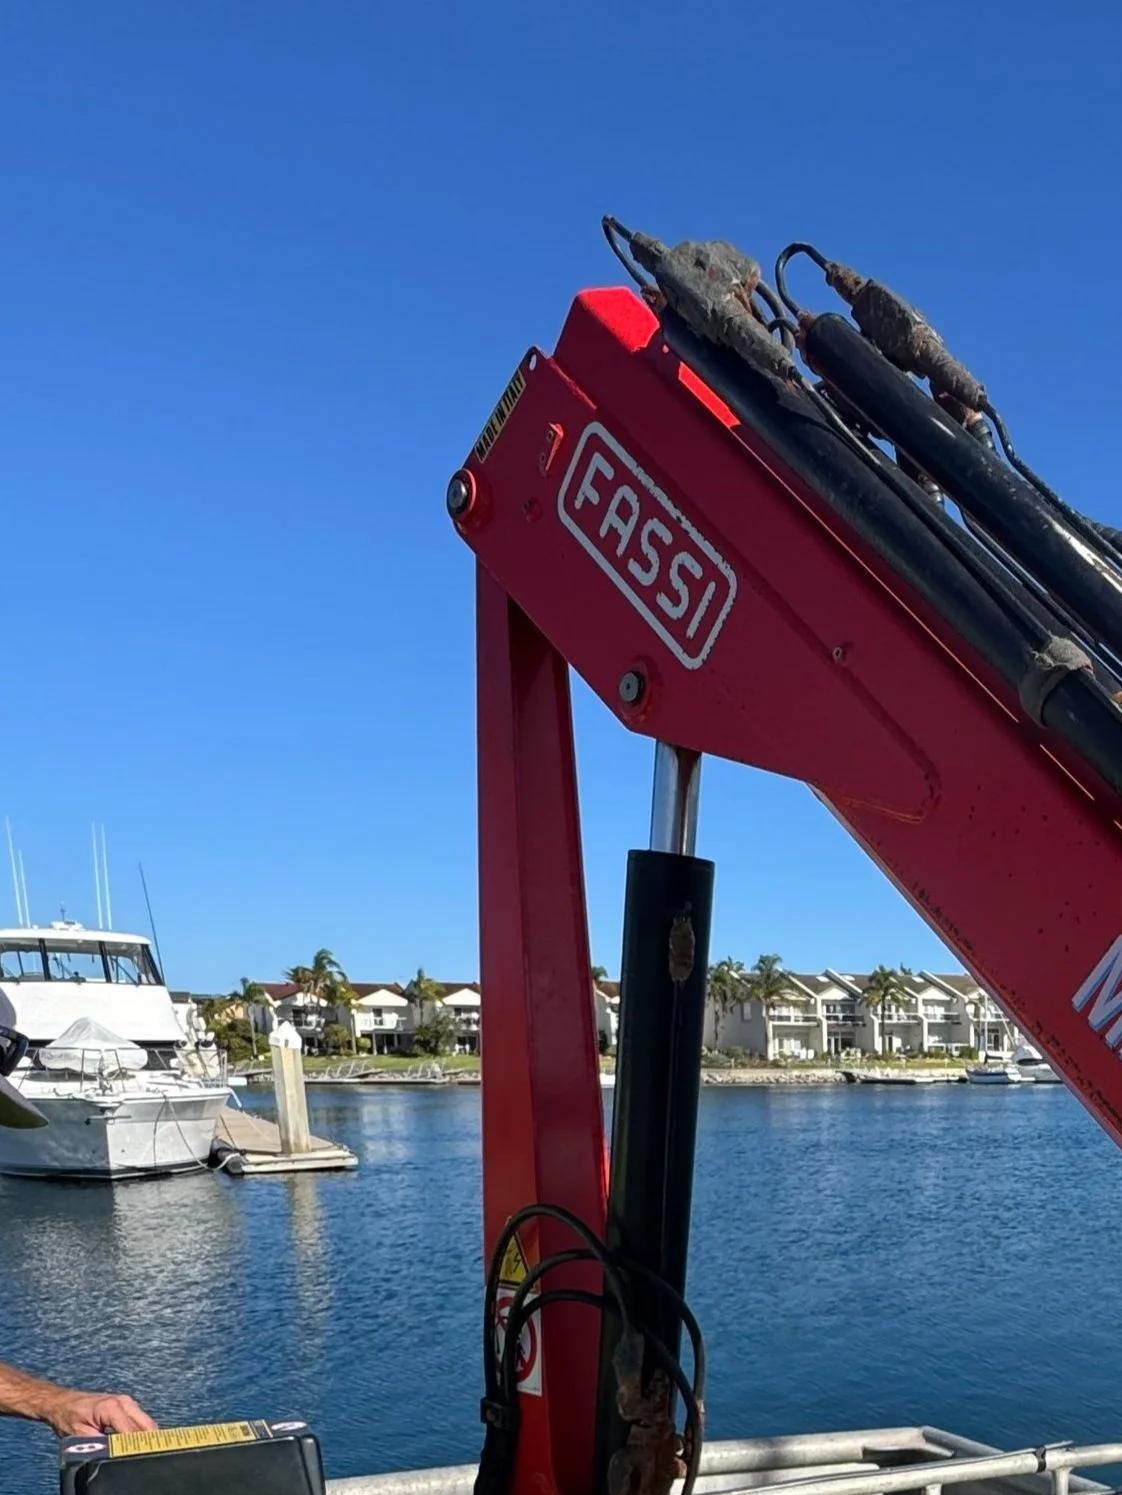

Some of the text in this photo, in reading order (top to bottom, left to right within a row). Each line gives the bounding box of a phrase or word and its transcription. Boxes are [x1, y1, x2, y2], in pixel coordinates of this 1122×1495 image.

[475, 373, 524, 459] MADE IN ITALY
[574, 451, 716, 640] FASSI
